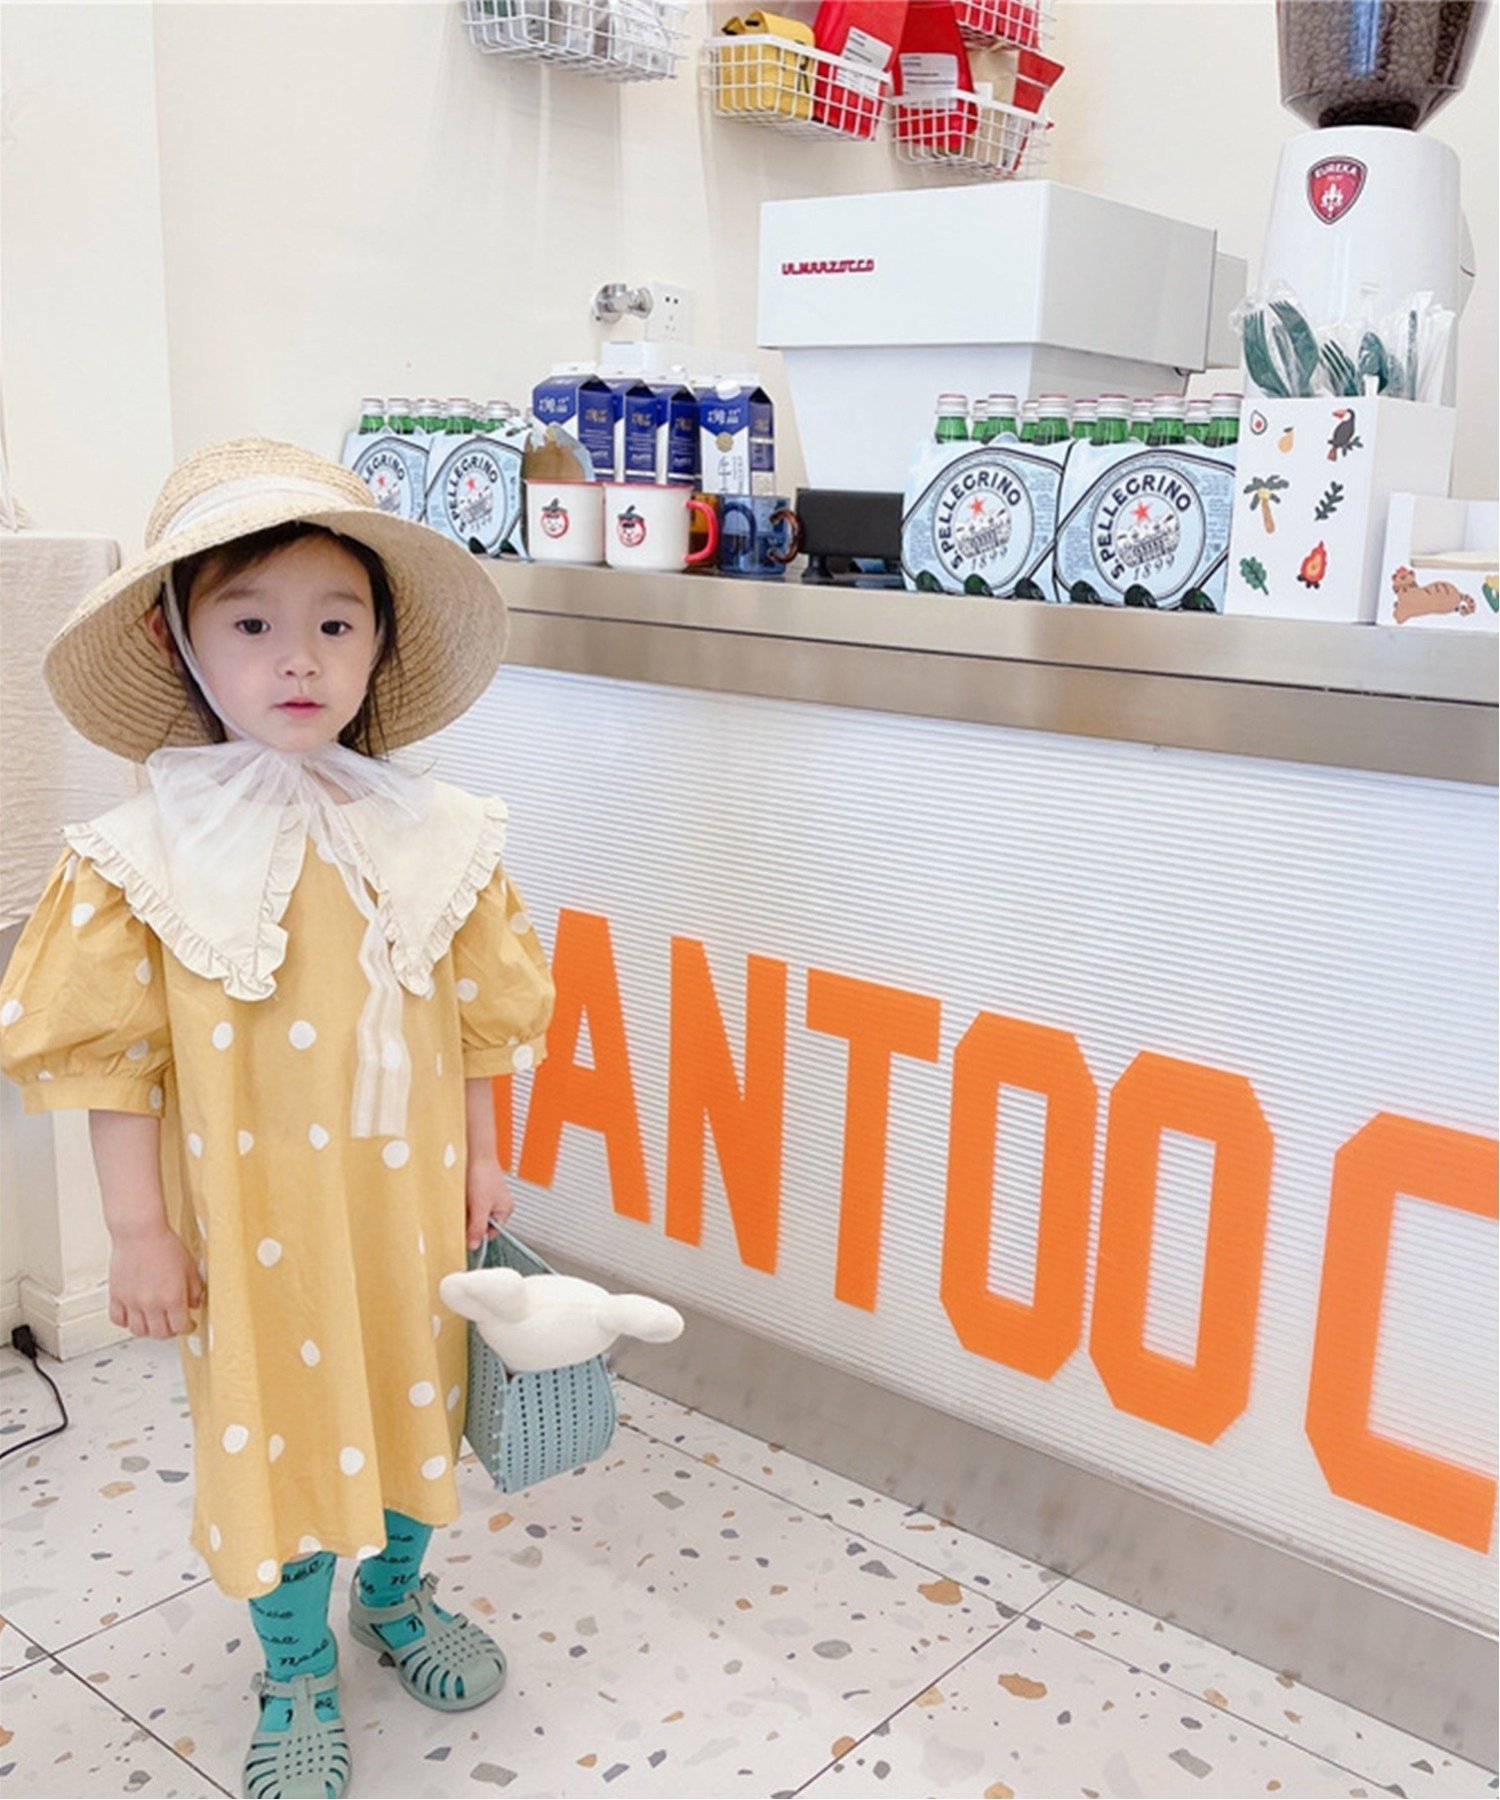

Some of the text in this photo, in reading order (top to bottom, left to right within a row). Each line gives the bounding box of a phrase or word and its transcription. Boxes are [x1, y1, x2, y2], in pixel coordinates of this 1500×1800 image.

[1314, 163, 1358, 179] EUREKA
[938, 470, 1022, 569] S.PELLEGRINO
[1097, 474, 1191, 579] S.PELLEGRINO
[971, 547, 1008, 570] 1899
[1133, 553, 1175, 581] 1899
[491, 907, 1274, 1446] ANTOO
